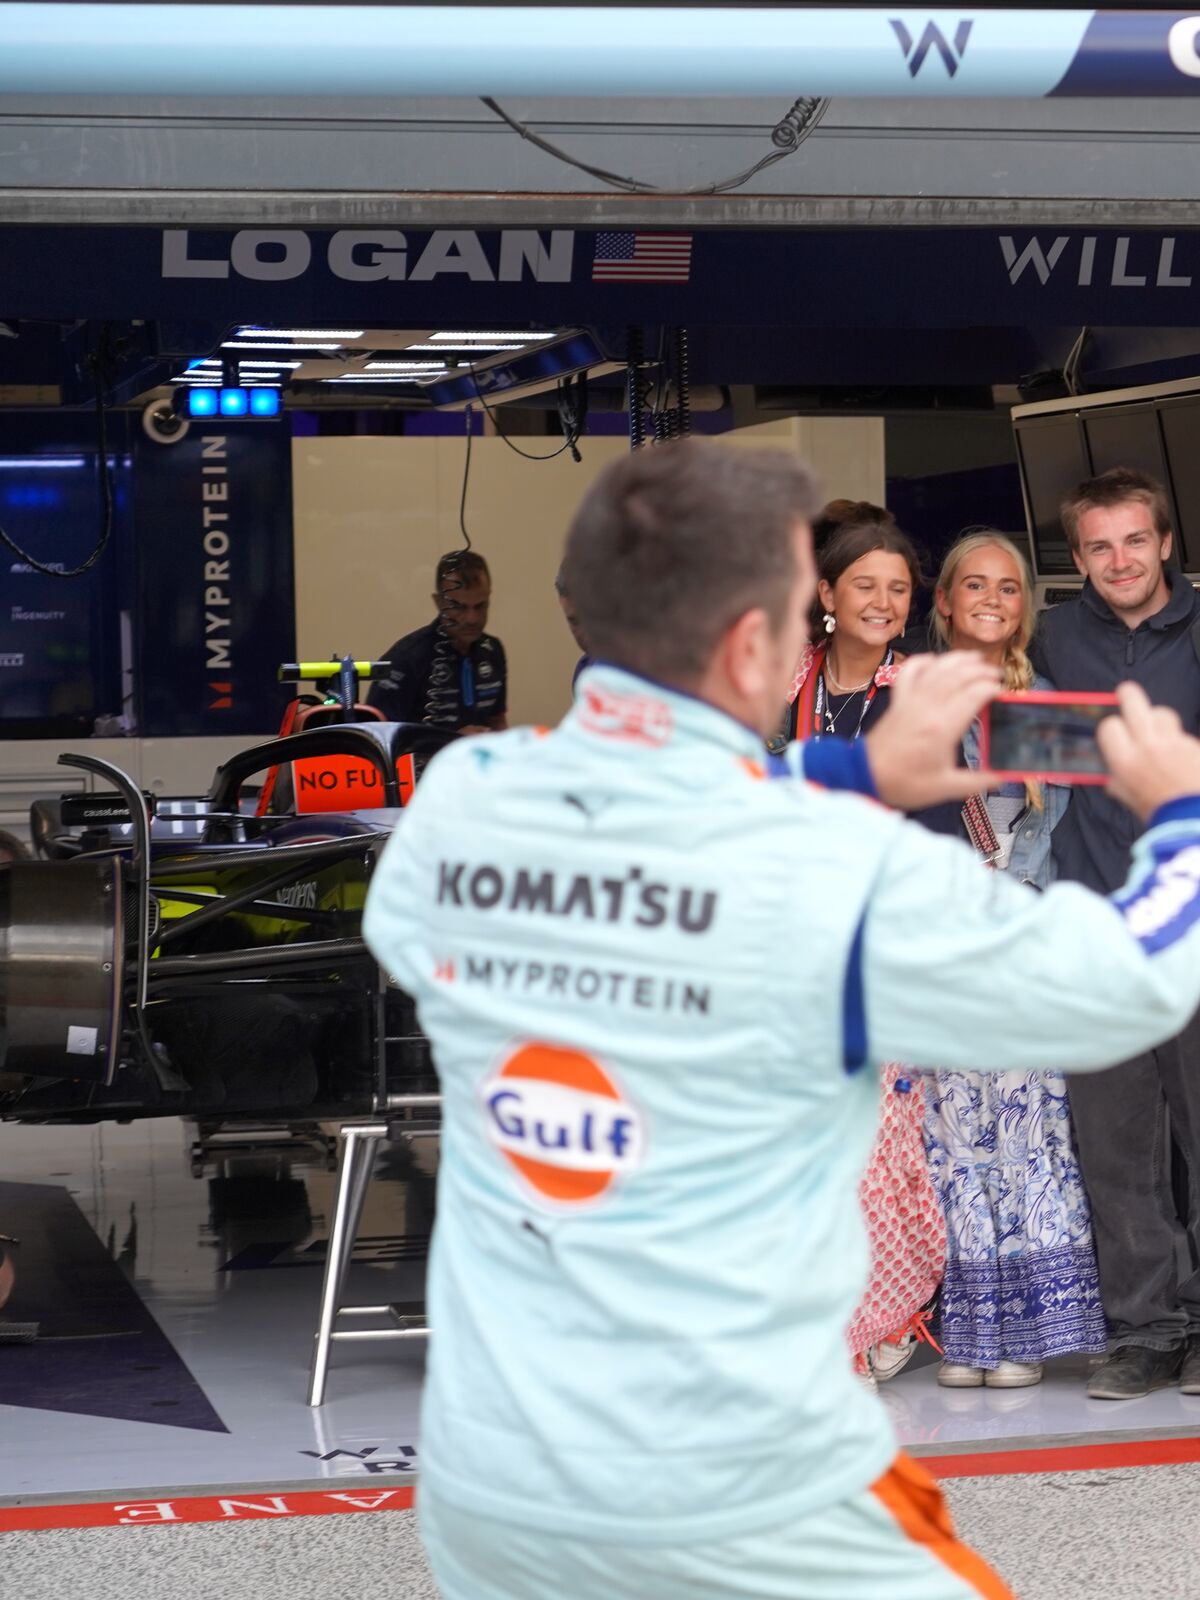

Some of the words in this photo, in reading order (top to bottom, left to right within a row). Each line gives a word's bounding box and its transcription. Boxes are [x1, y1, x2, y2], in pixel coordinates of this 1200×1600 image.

[162, 230, 574, 283] LOGAN
[202, 435, 233, 669] MYPROTEIN
[301, 771, 338, 791] NO
[438, 859, 717, 934] KOMATSU
[466, 955, 711, 1014] MYPROTEIN
[488, 1091, 630, 1157] Gulf
